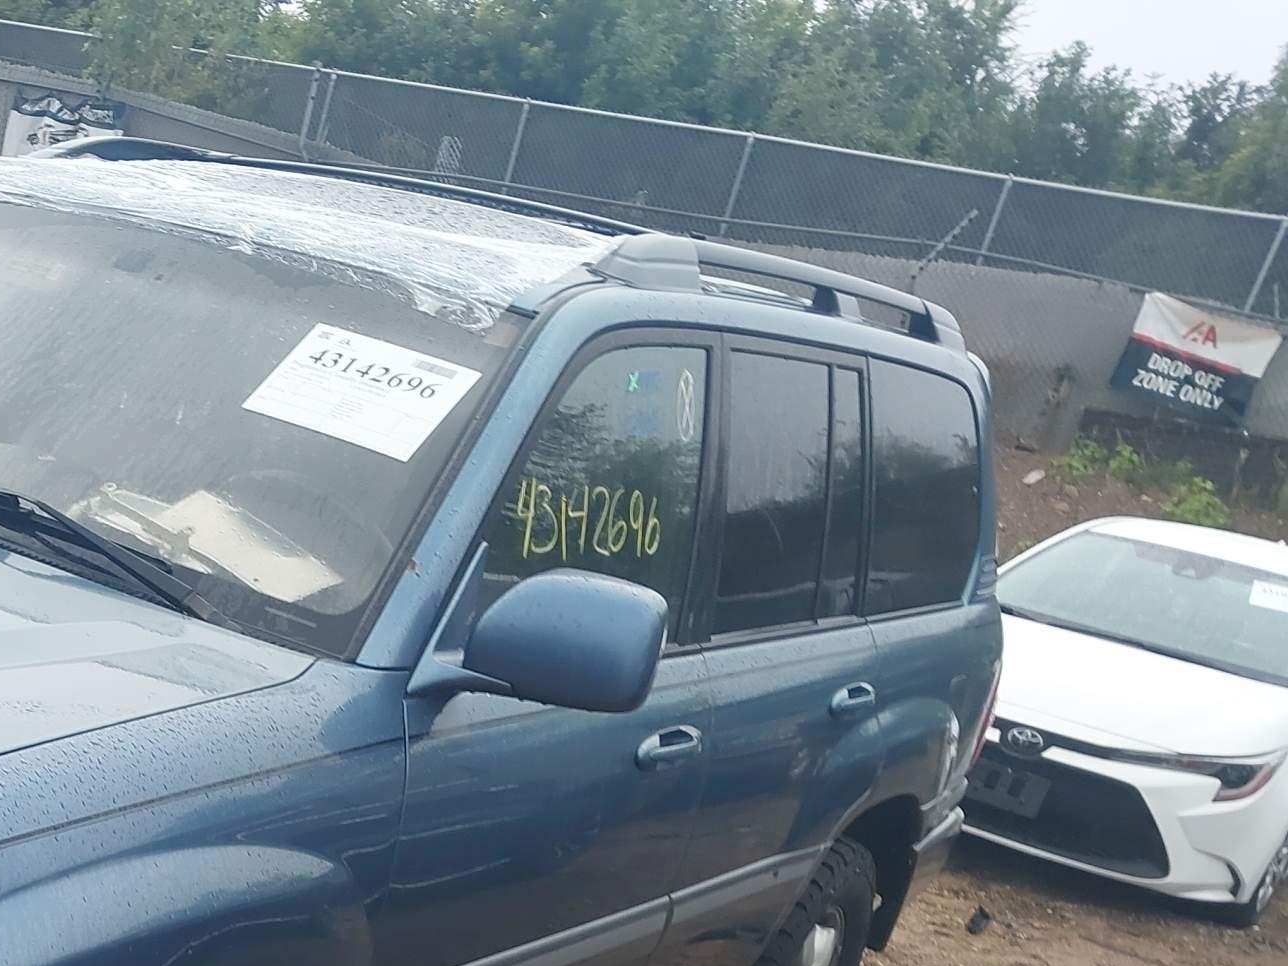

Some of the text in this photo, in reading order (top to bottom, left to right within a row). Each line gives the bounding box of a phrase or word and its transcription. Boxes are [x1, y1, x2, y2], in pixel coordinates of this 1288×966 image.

[309, 349, 443, 399] 43142696
[1132, 369, 1225, 410] ZONE ONLY
[1146, 352, 1225, 392] DROP OFF
[517, 478, 661, 560] 43142696
